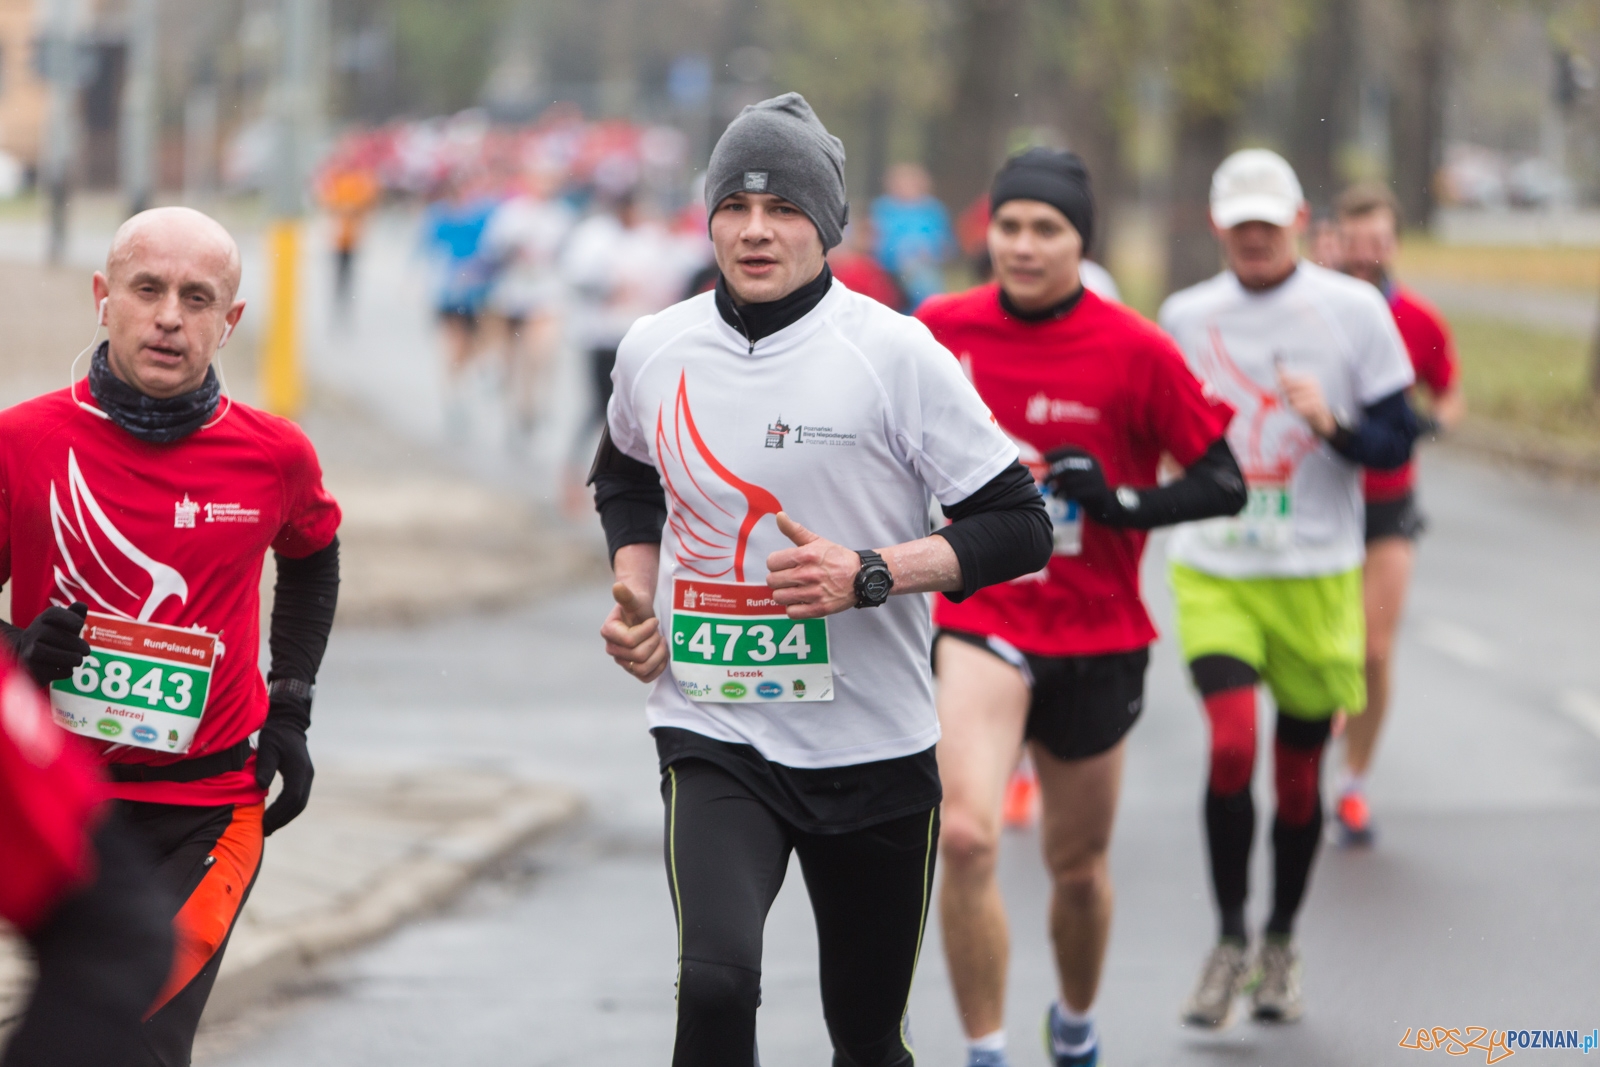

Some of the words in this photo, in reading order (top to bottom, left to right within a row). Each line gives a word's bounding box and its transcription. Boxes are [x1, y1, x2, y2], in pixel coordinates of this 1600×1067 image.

[795, 425, 803, 443] 1
[204, 502, 215, 522] 1
[143, 638, 206, 659] RunPoland.org
[688, 622, 811, 662] 4734
[72, 655, 193, 711] 6843
[727, 670, 763, 678] Leszek
[105, 706, 145, 722] Andrzej
